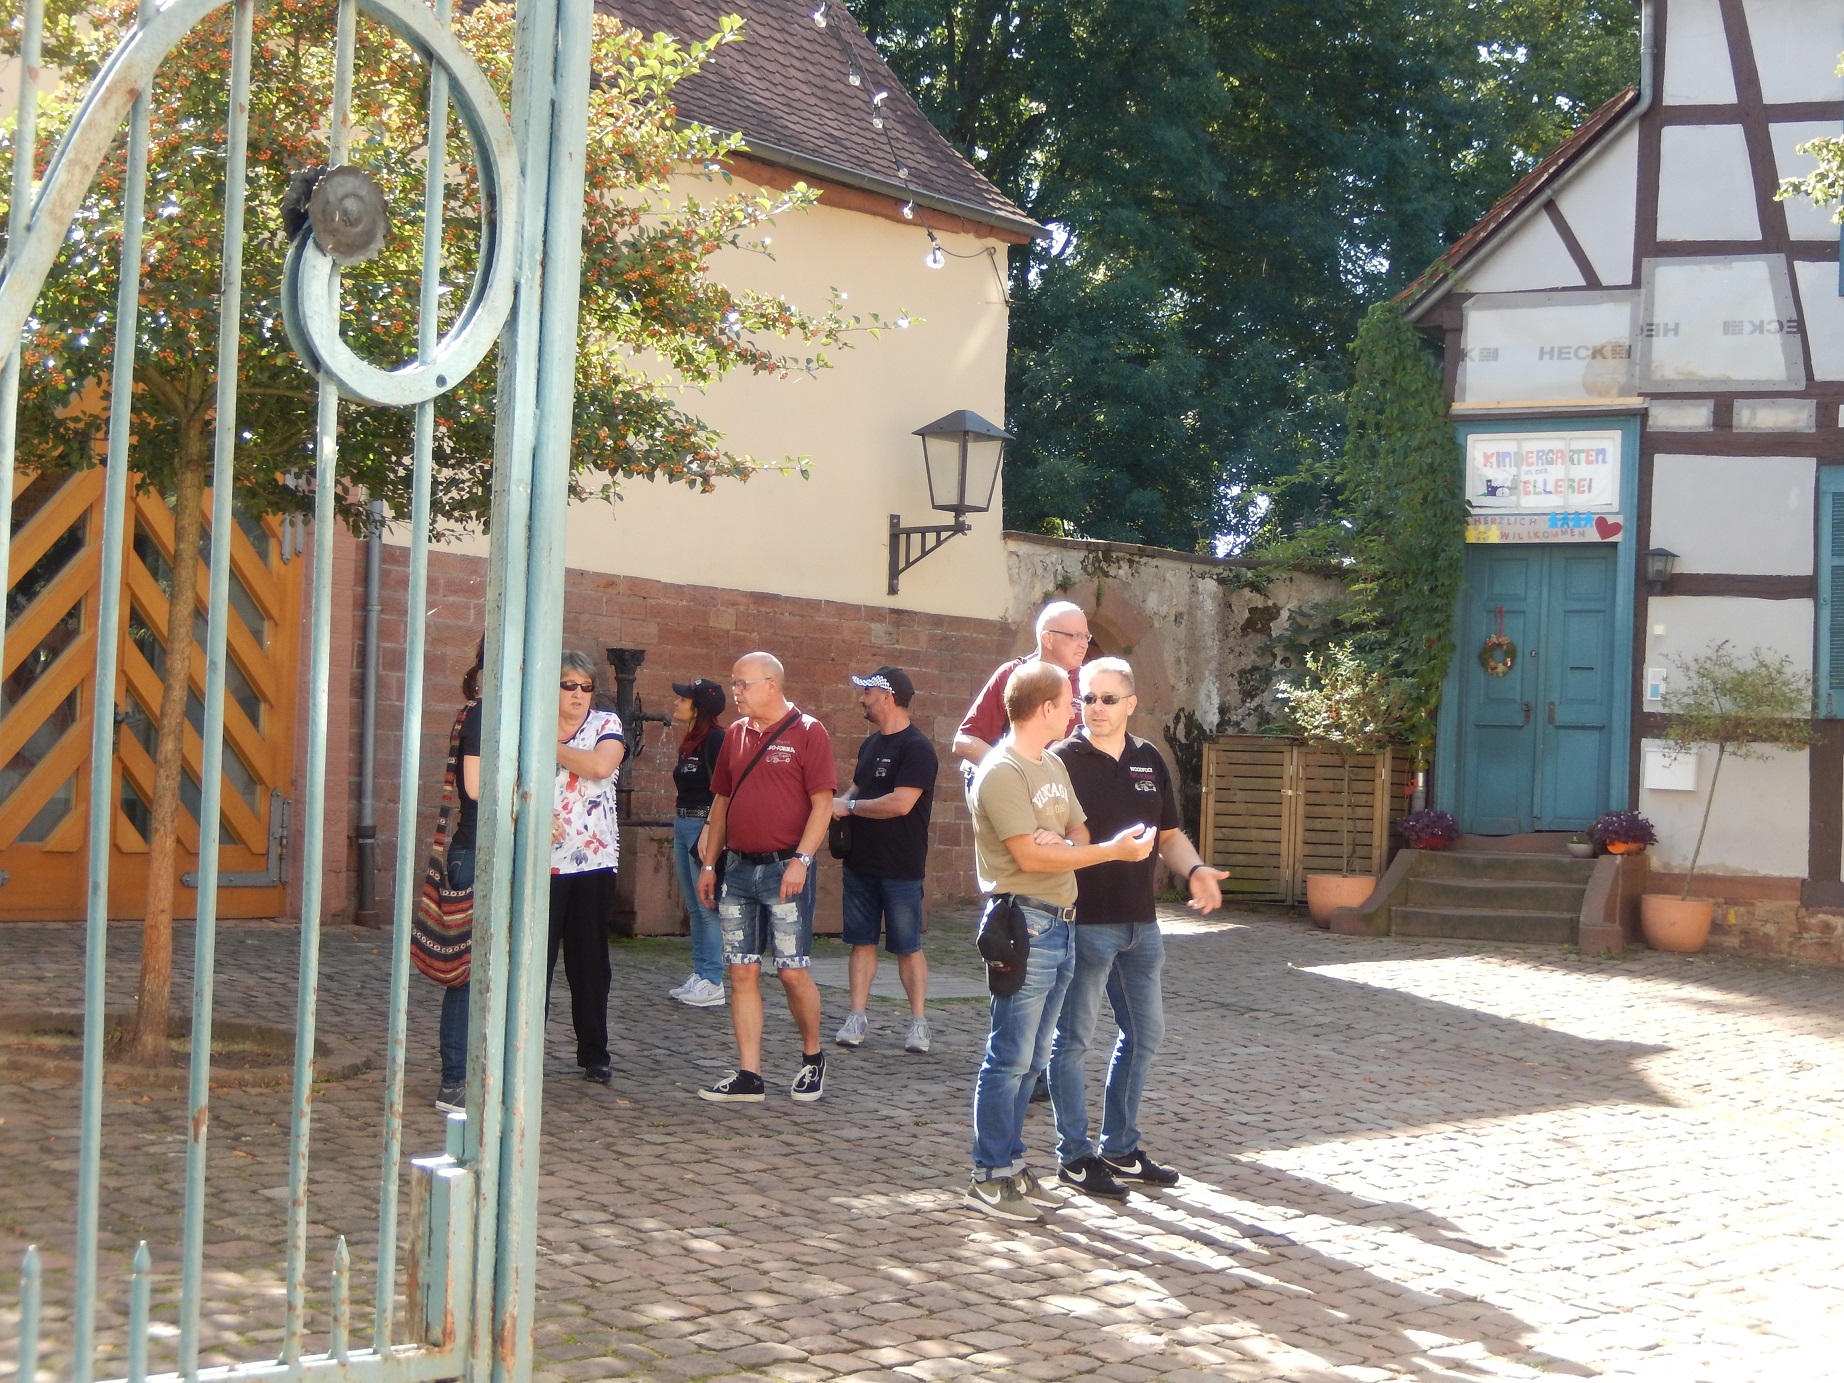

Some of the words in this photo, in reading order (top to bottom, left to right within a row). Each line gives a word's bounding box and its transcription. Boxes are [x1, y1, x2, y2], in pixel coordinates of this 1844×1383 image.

[1538, 344, 1608, 361] HECK
[1474, 516, 1538, 527] HERZLICH
[1501, 528, 1587, 542] WILLKOMMEN
